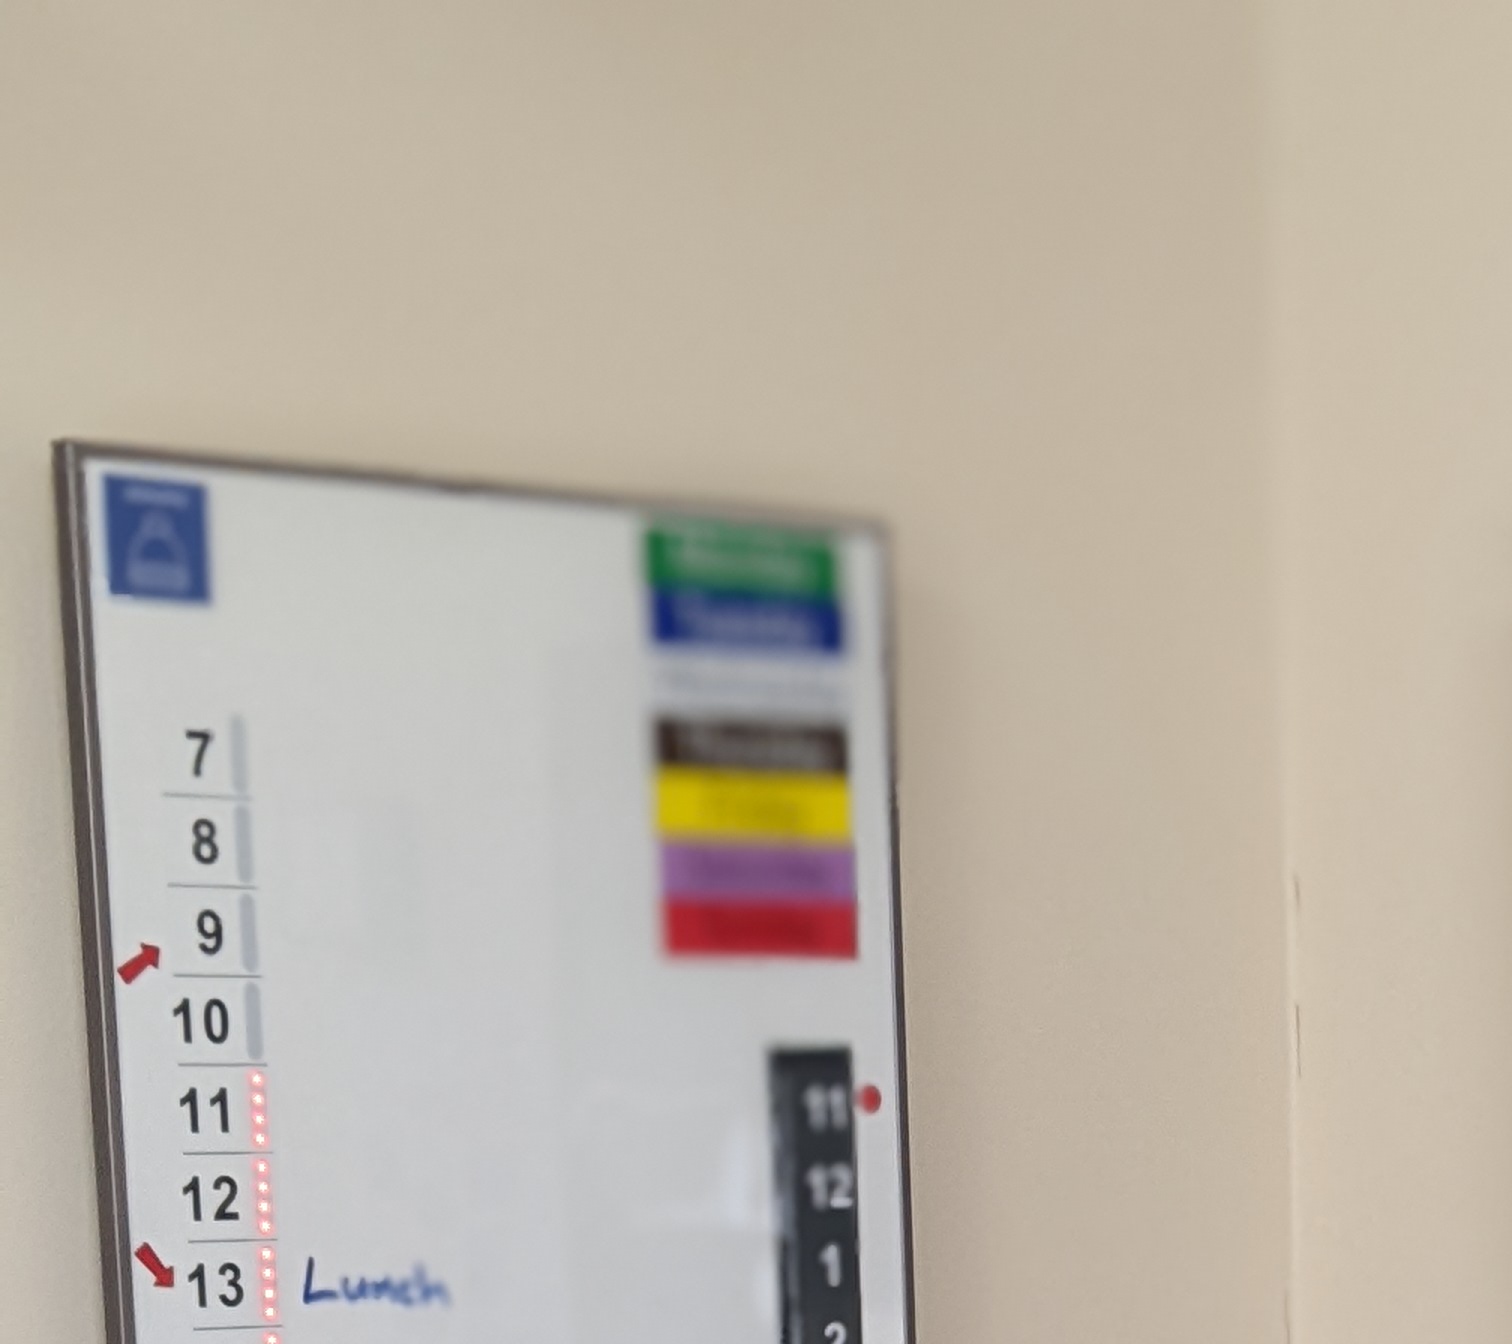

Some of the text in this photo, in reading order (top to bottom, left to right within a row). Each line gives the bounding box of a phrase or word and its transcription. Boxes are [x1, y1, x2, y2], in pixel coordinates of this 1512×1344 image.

[186, 728, 214, 778] 7
[192, 817, 219, 865] 8
[197, 909, 223, 955] 9
[173, 998, 229, 1044] 10
[179, 1087, 230, 1134] 11
[182, 1175, 240, 1222] 12
[806, 1162, 853, 1211] 12
[188, 1262, 244, 1308] 13
[302, 1256, 452, 1309] Lunch
[818, 1244, 842, 1288] 1
